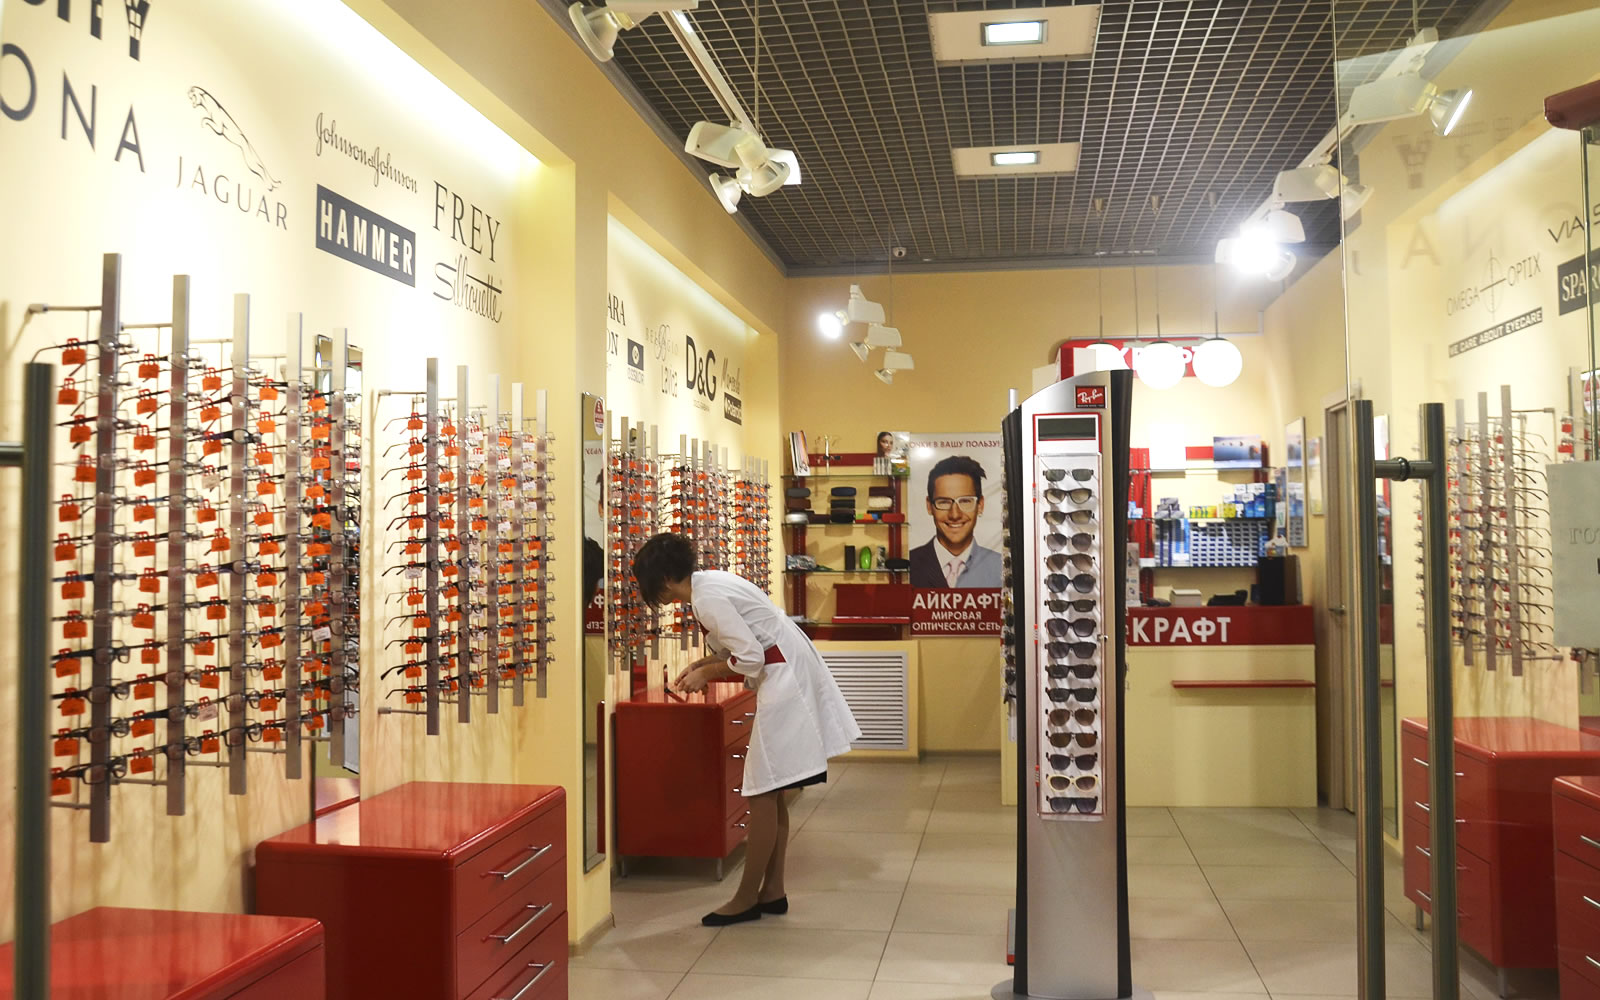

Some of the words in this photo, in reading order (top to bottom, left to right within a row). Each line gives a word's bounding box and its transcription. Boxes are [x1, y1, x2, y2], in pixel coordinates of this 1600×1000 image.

[176, 156, 288, 230] JAGUAR
[320, 199, 414, 276] HAMMER
[433, 180, 501, 263] FREY
[1507, 252, 1542, 286] OPTIX
[1479, 326, 1504, 343] ABOUT
[1505, 310, 1543, 334] EYECARE
[686, 335, 717, 402] D&G
[912, 591, 1000, 609] АЙКРАФТ
[931, 611, 981, 620] МИРОВАЯ
[912, 622, 976, 631] ОПТИЧЕСКАЯ
[978, 622, 1000, 631] СЕТЬ
